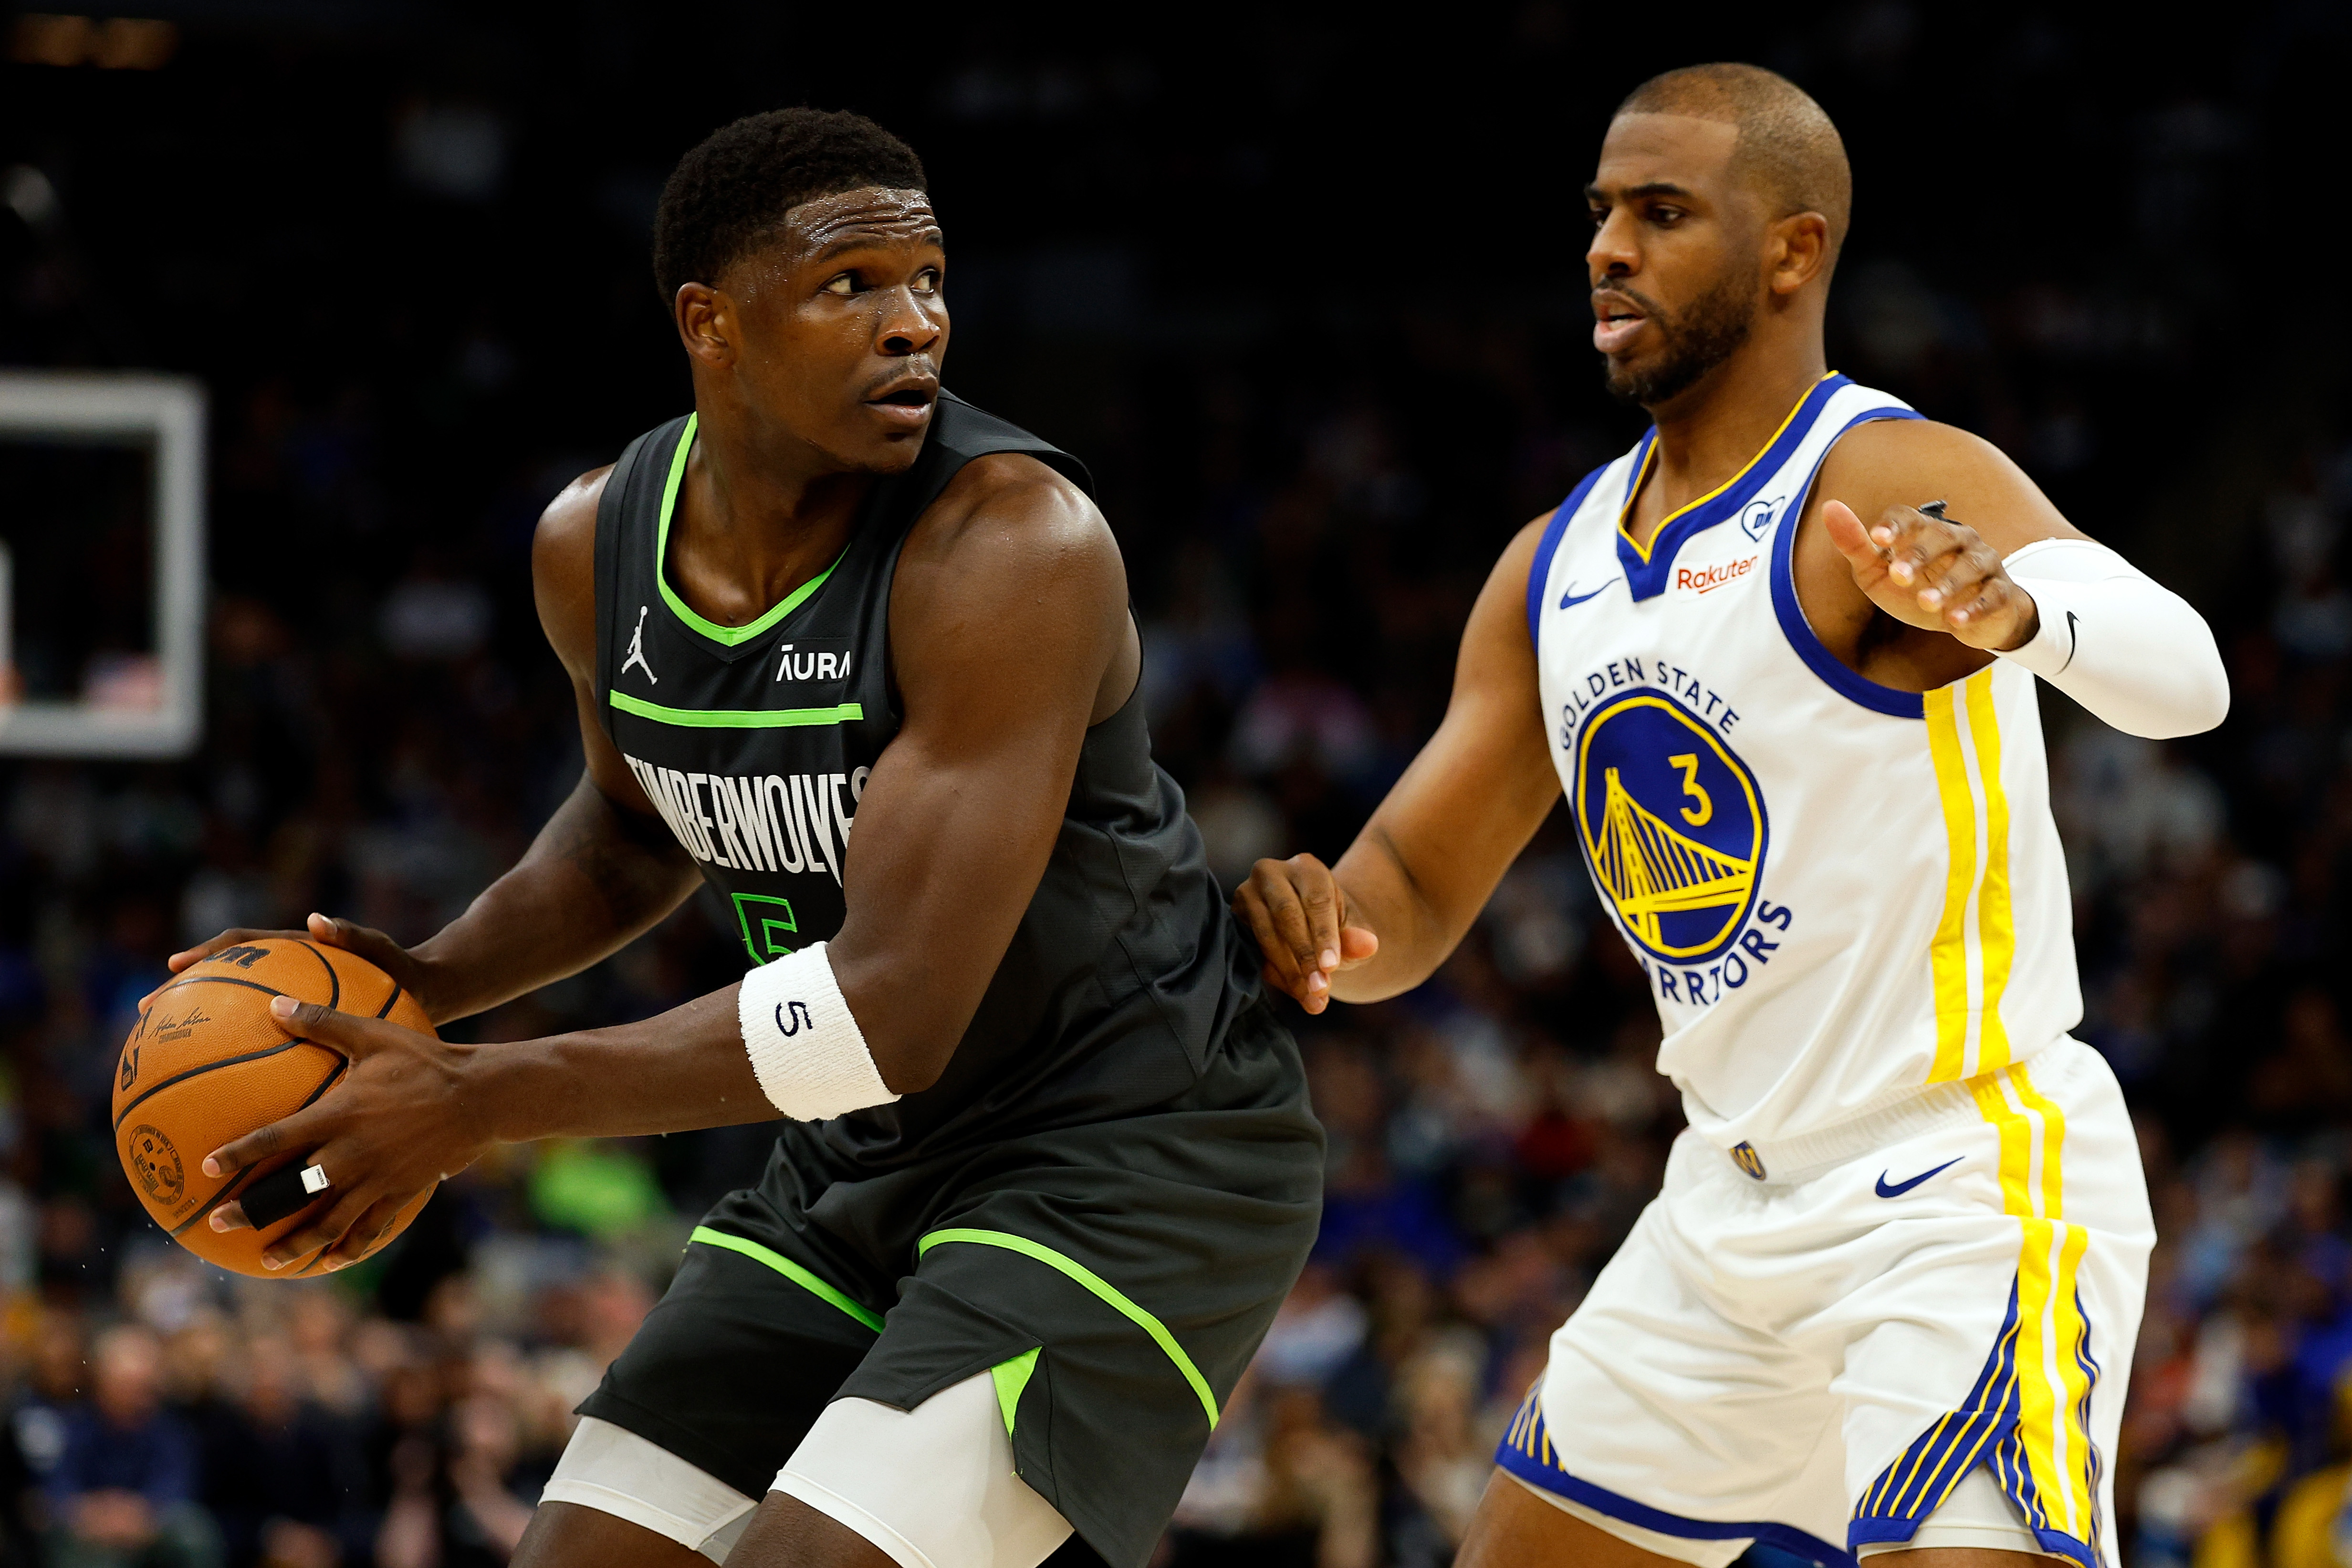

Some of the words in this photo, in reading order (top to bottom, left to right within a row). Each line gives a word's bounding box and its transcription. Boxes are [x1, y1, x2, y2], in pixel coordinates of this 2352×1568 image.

[1678, 555, 1757, 590] Rakuten
[1560, 657, 1645, 750] GOLDEN
[1658, 660, 1740, 734] STATE
[1668, 753, 1713, 827] 3
[1642, 900, 1792, 1005] RRIORS
[775, 1001, 813, 1037] 5
